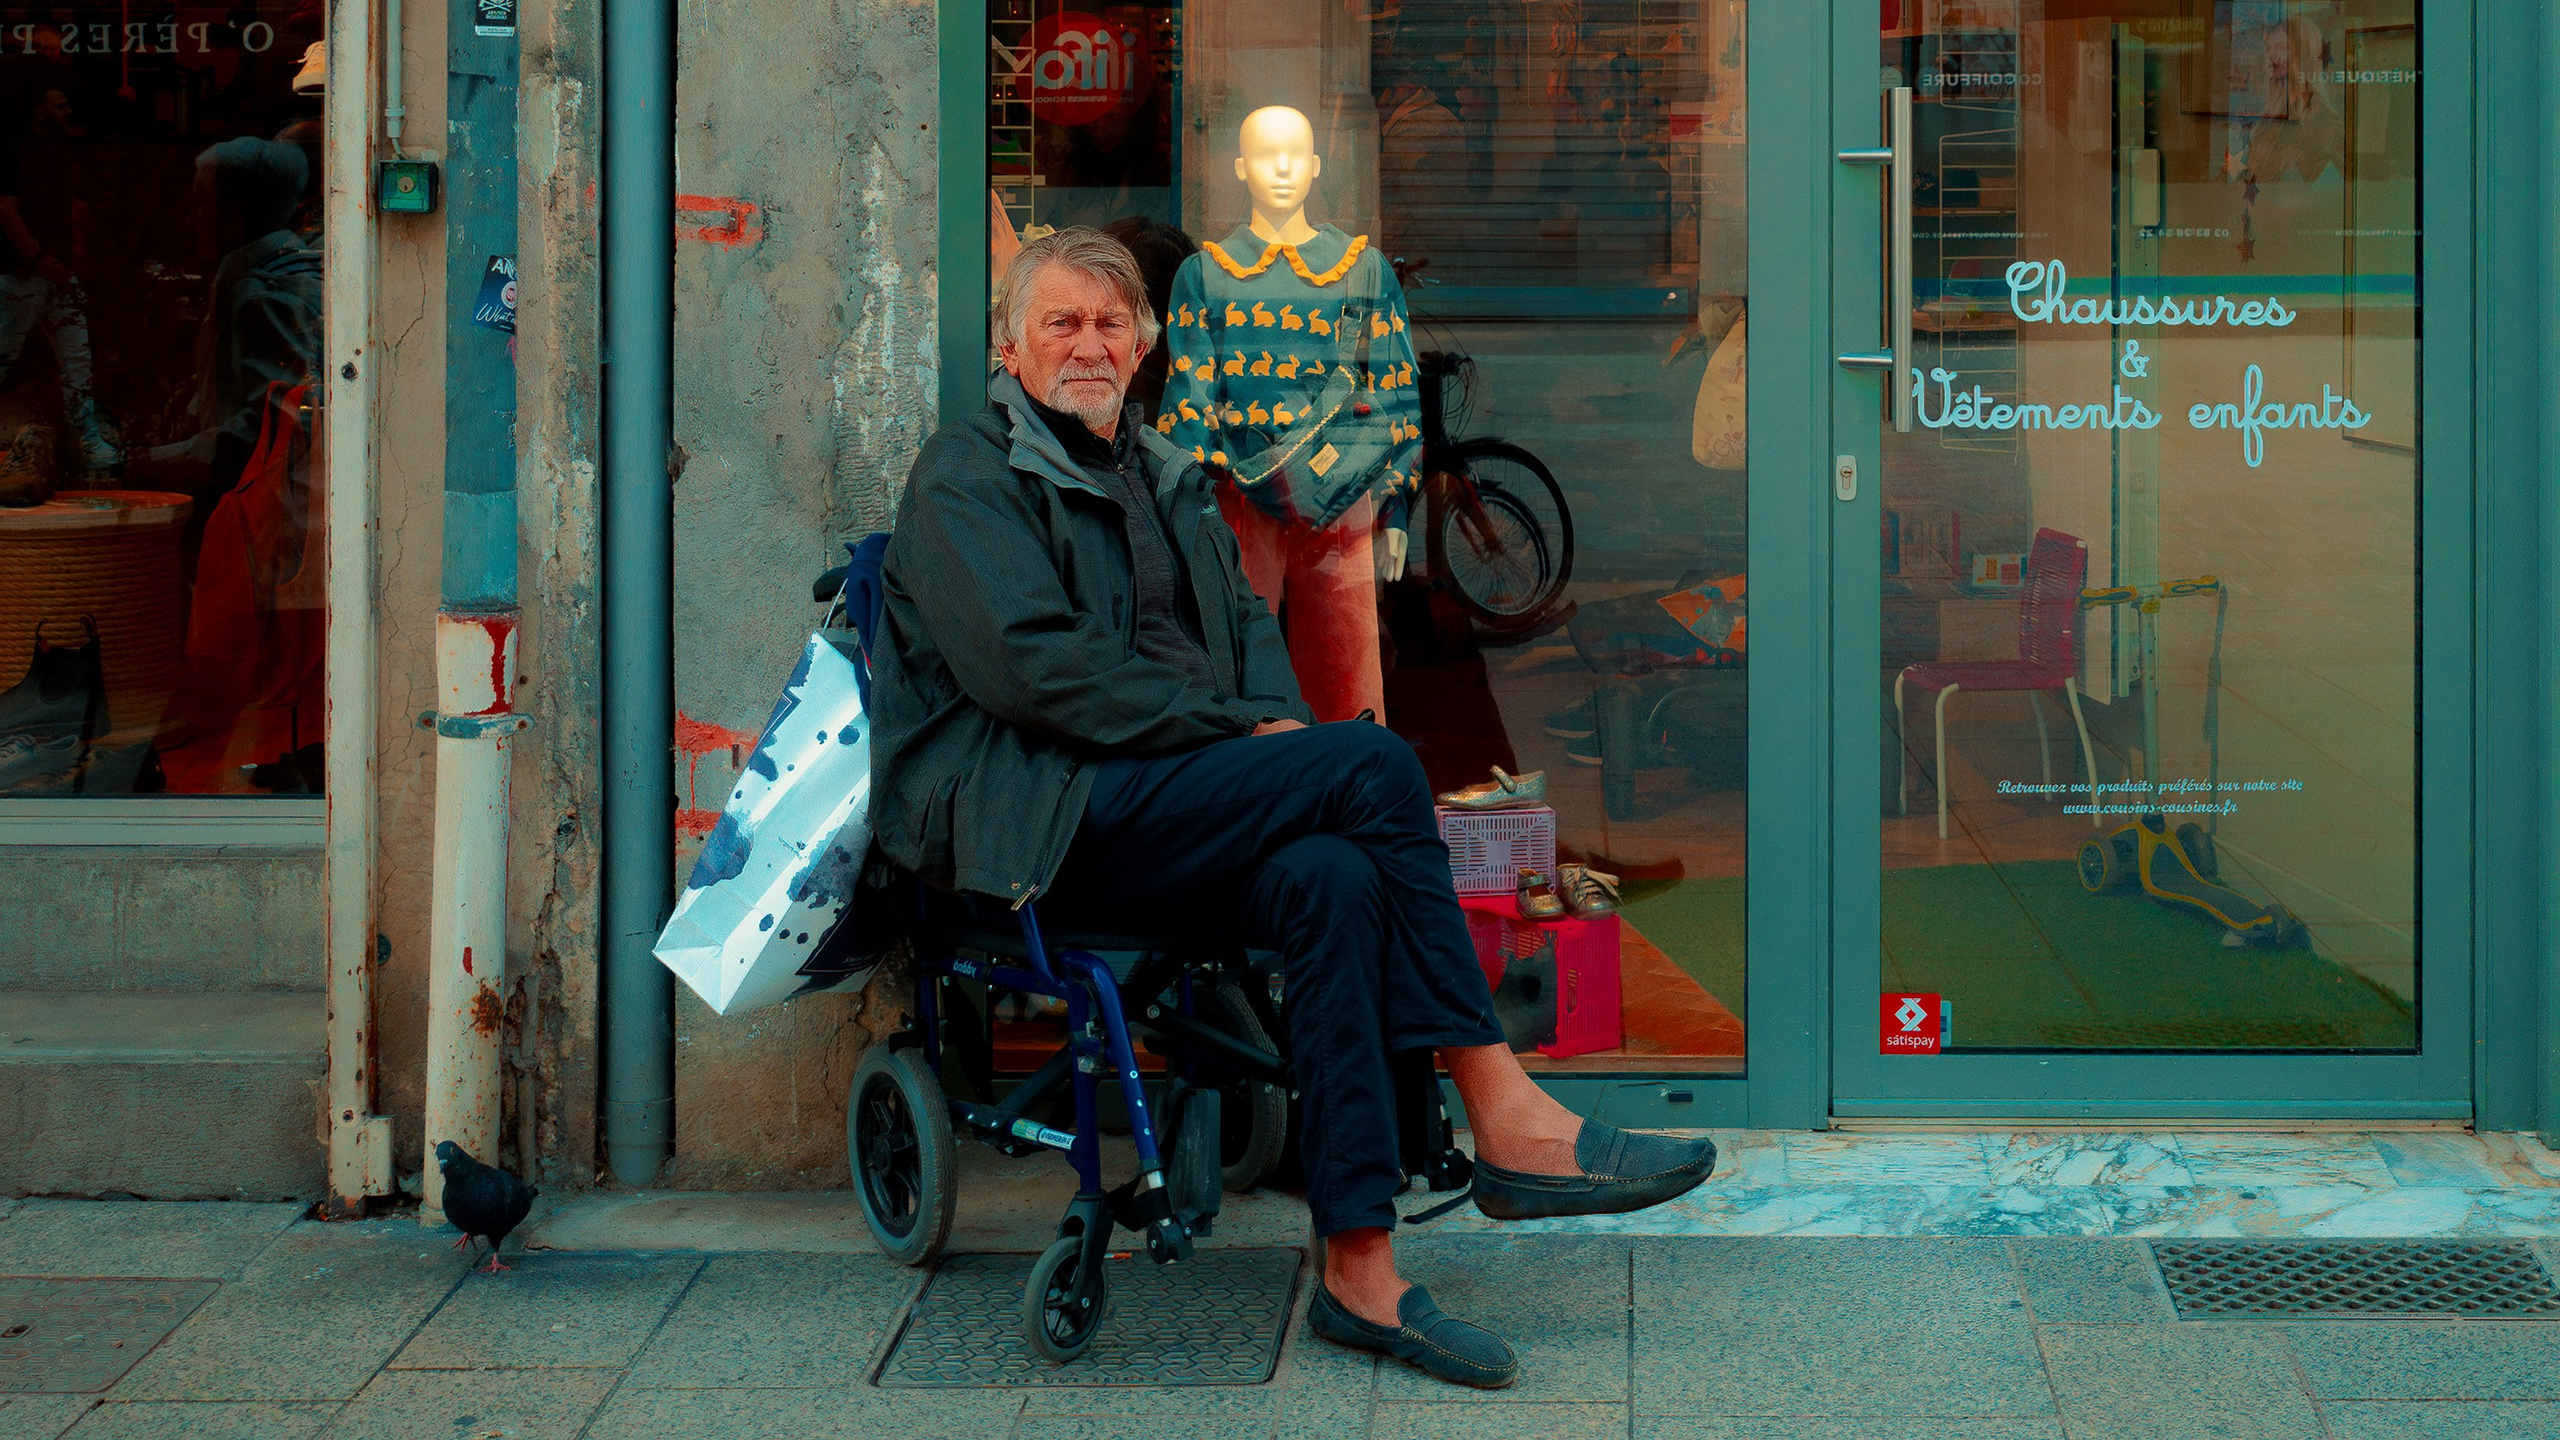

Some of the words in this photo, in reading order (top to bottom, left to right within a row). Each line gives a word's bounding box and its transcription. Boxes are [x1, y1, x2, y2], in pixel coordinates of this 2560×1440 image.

[2005, 259, 2296, 327] Chaussures
[2120, 339, 2149, 379] &
[1911, 366, 2162, 429] Vêtements
[2189, 364, 2371, 468] enfants
[1997, 779, 2067, 794] Retrouvez
[2070, 783, 2092, 793] vos
[2095, 779, 2154, 796] produits
[2157, 778, 2213, 796] préférés
[2217, 782, 2241, 792] sur
[2243, 779, 2278, 791] notre
[2280, 778, 2304, 791] site
[2063, 798, 2239, 816] www.cousins-cousines.fr
